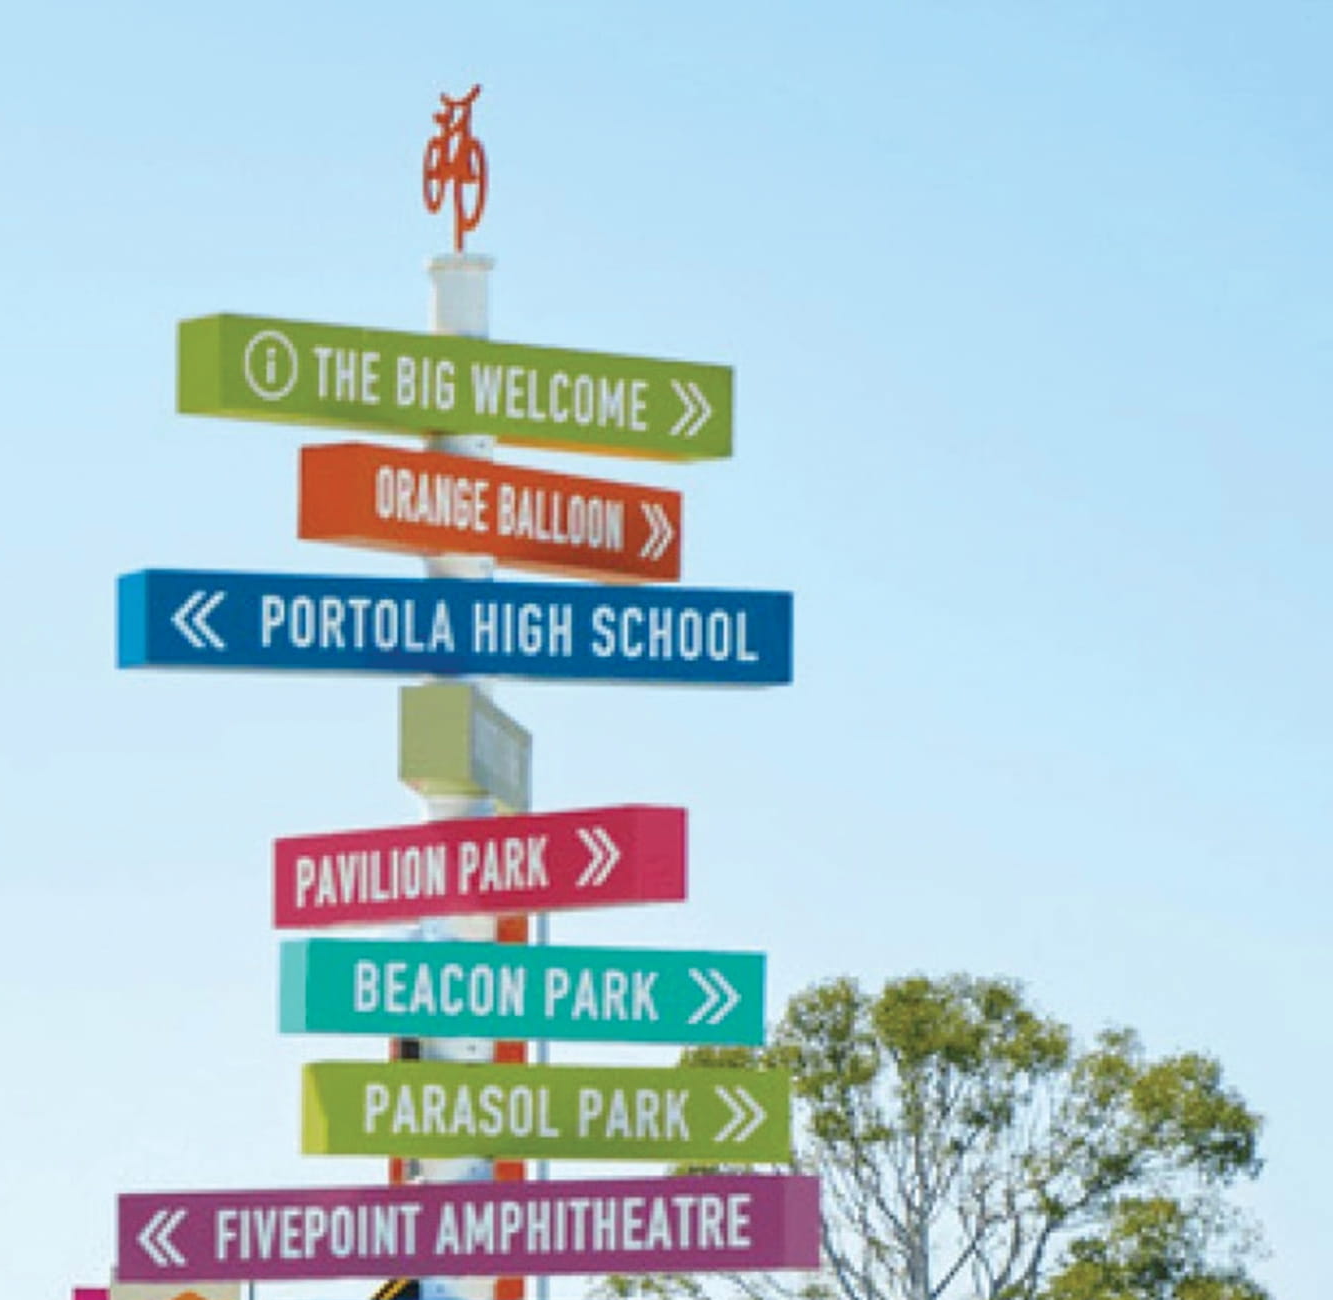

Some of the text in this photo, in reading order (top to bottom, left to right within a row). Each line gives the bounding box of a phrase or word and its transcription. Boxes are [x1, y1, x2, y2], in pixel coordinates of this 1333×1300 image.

[313, 346, 649, 432] THE BIG WELCOME
[375, 466, 624, 551] ORANGE BALLOON
[261, 595, 759, 662] PORTOLA HIGH SCHOOL
[295, 835, 550, 908] PAVILION PARK
[353, 960, 659, 1022] BEACON PARK
[364, 1084, 690, 1141] PARASOL PARK
[214, 1193, 753, 1262] FIVEPOINT AMPHITHEATRE
